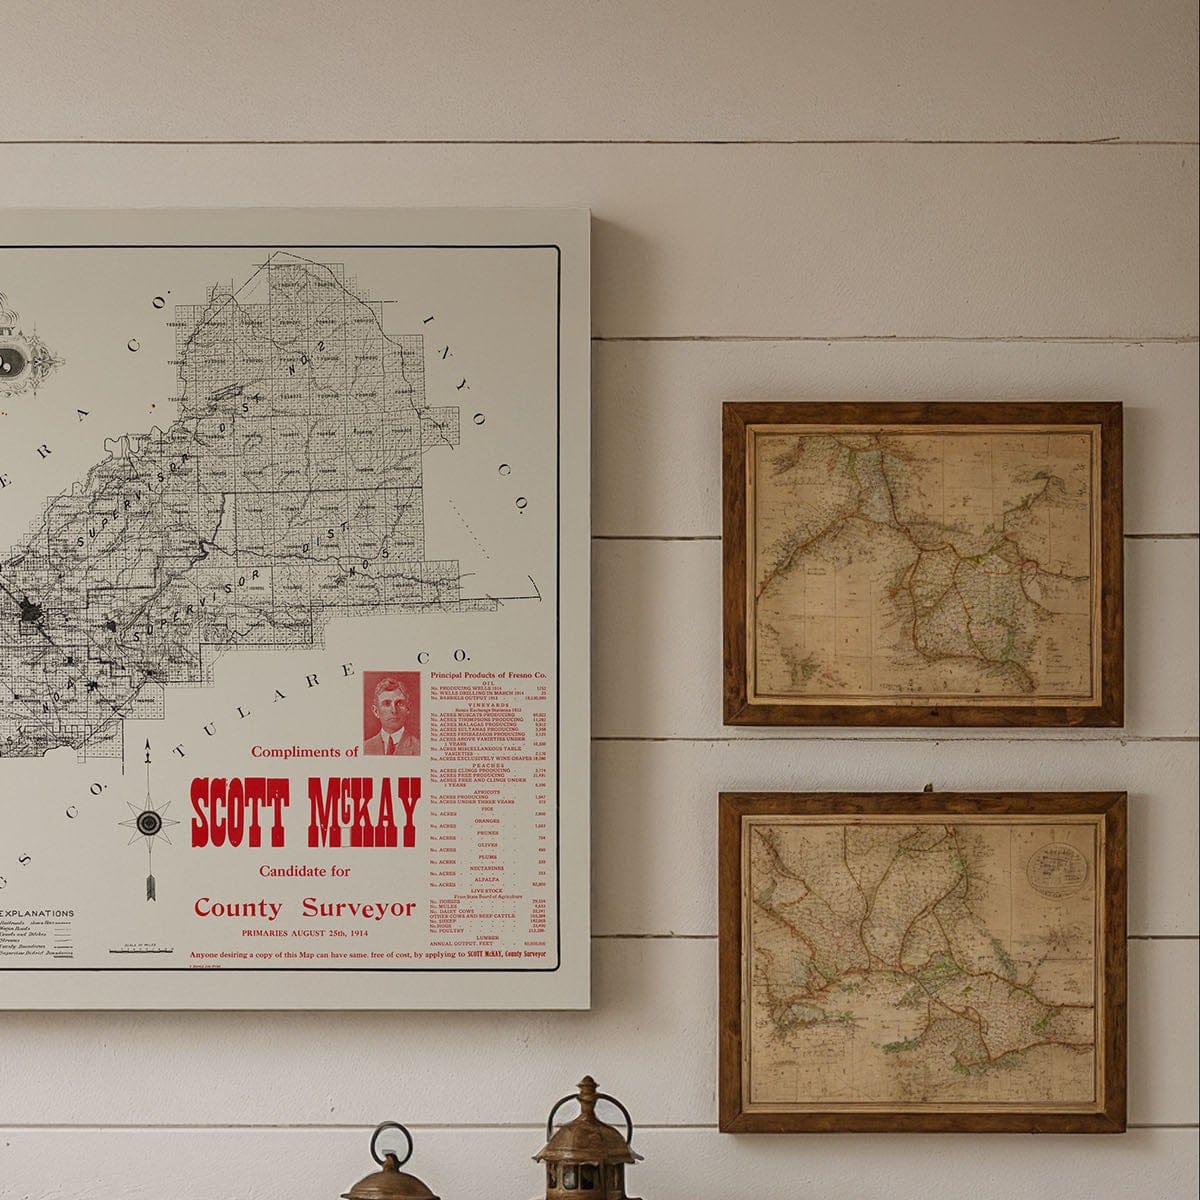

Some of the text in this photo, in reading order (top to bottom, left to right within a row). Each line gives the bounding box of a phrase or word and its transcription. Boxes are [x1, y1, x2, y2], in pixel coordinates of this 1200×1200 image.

[251, 745, 359, 759] Compliments of
[190, 777, 289, 848] SCOTT
[259, 864, 351, 878] Candidate for
[194, 897, 417, 921] County Surveyor
[329, 930, 348, 938] 25th,
